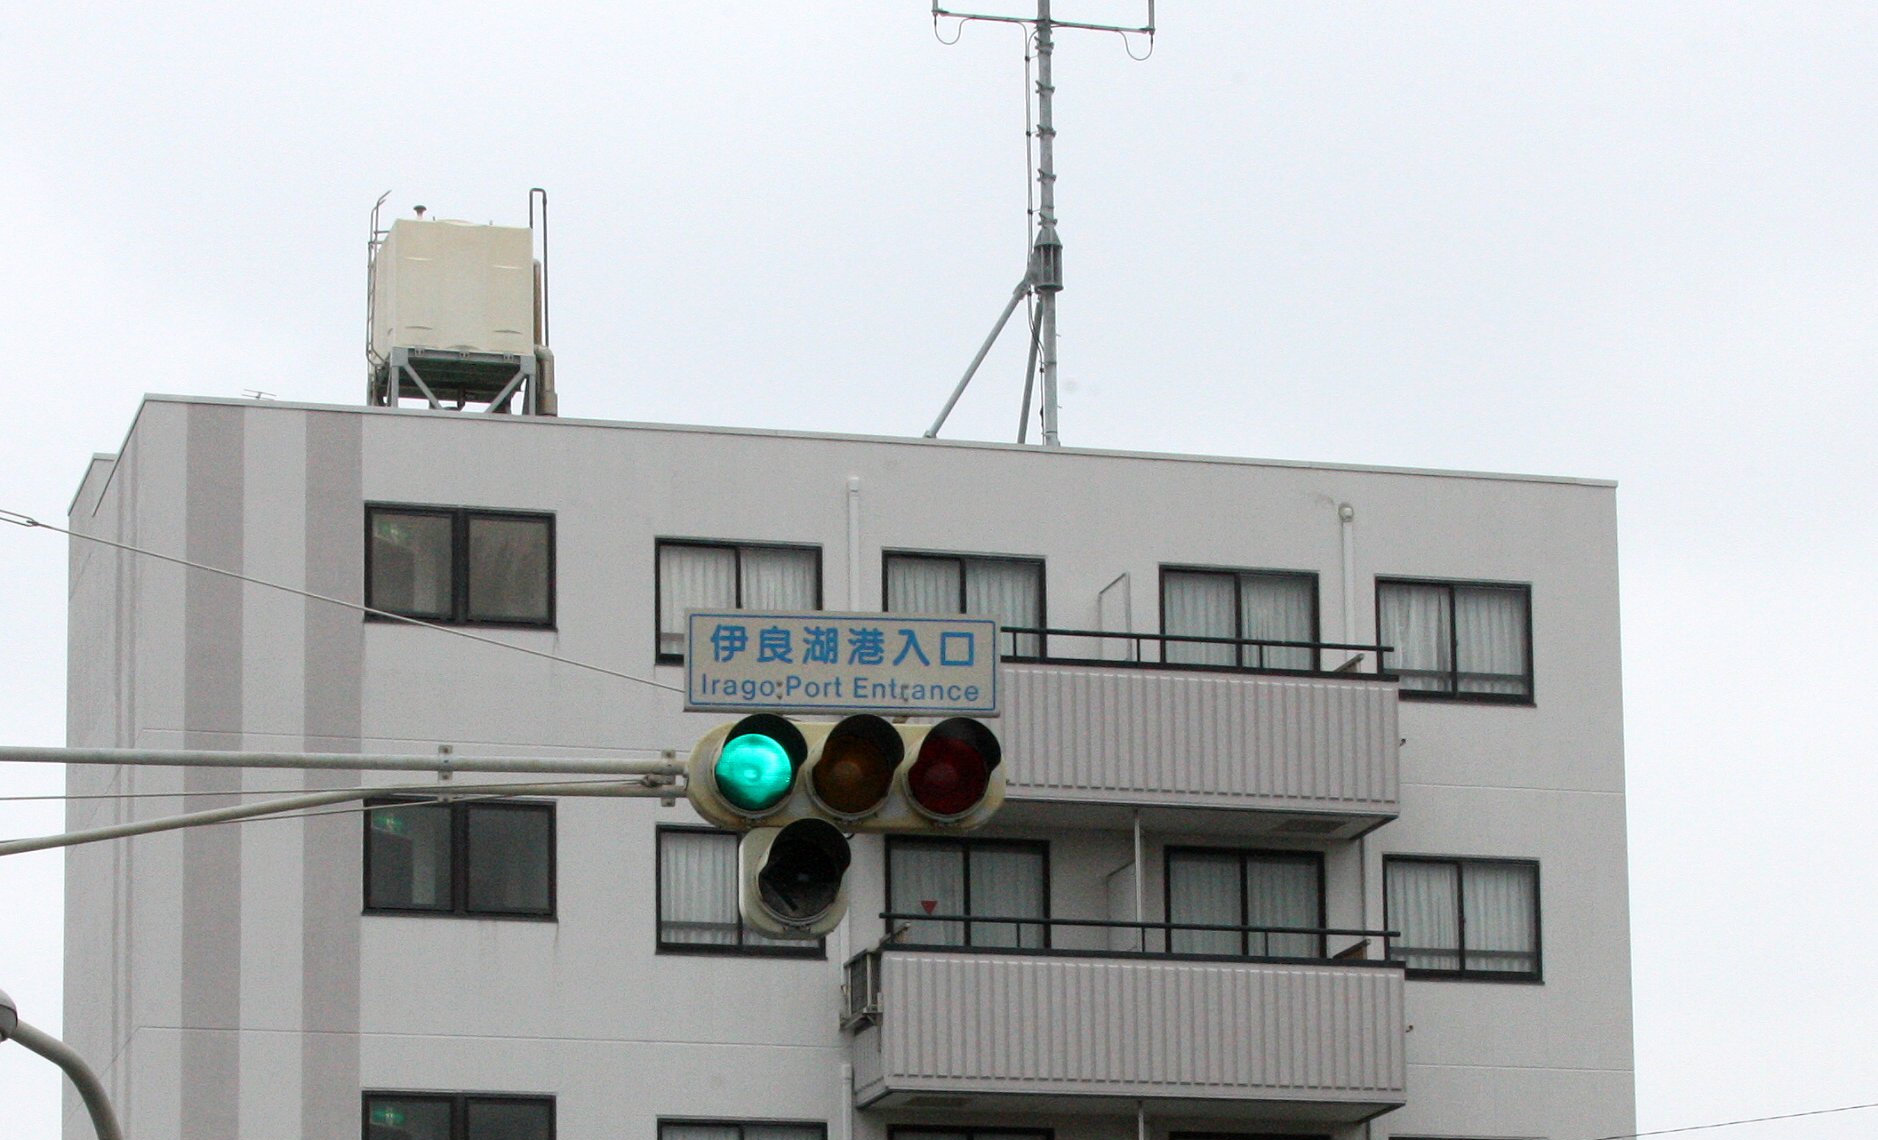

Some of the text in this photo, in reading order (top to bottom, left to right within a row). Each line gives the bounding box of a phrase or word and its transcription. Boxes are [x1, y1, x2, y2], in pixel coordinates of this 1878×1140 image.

[710, 623, 974, 667] 伊良湖港入口
[702, 673, 979, 701] Irago Port Entrance
